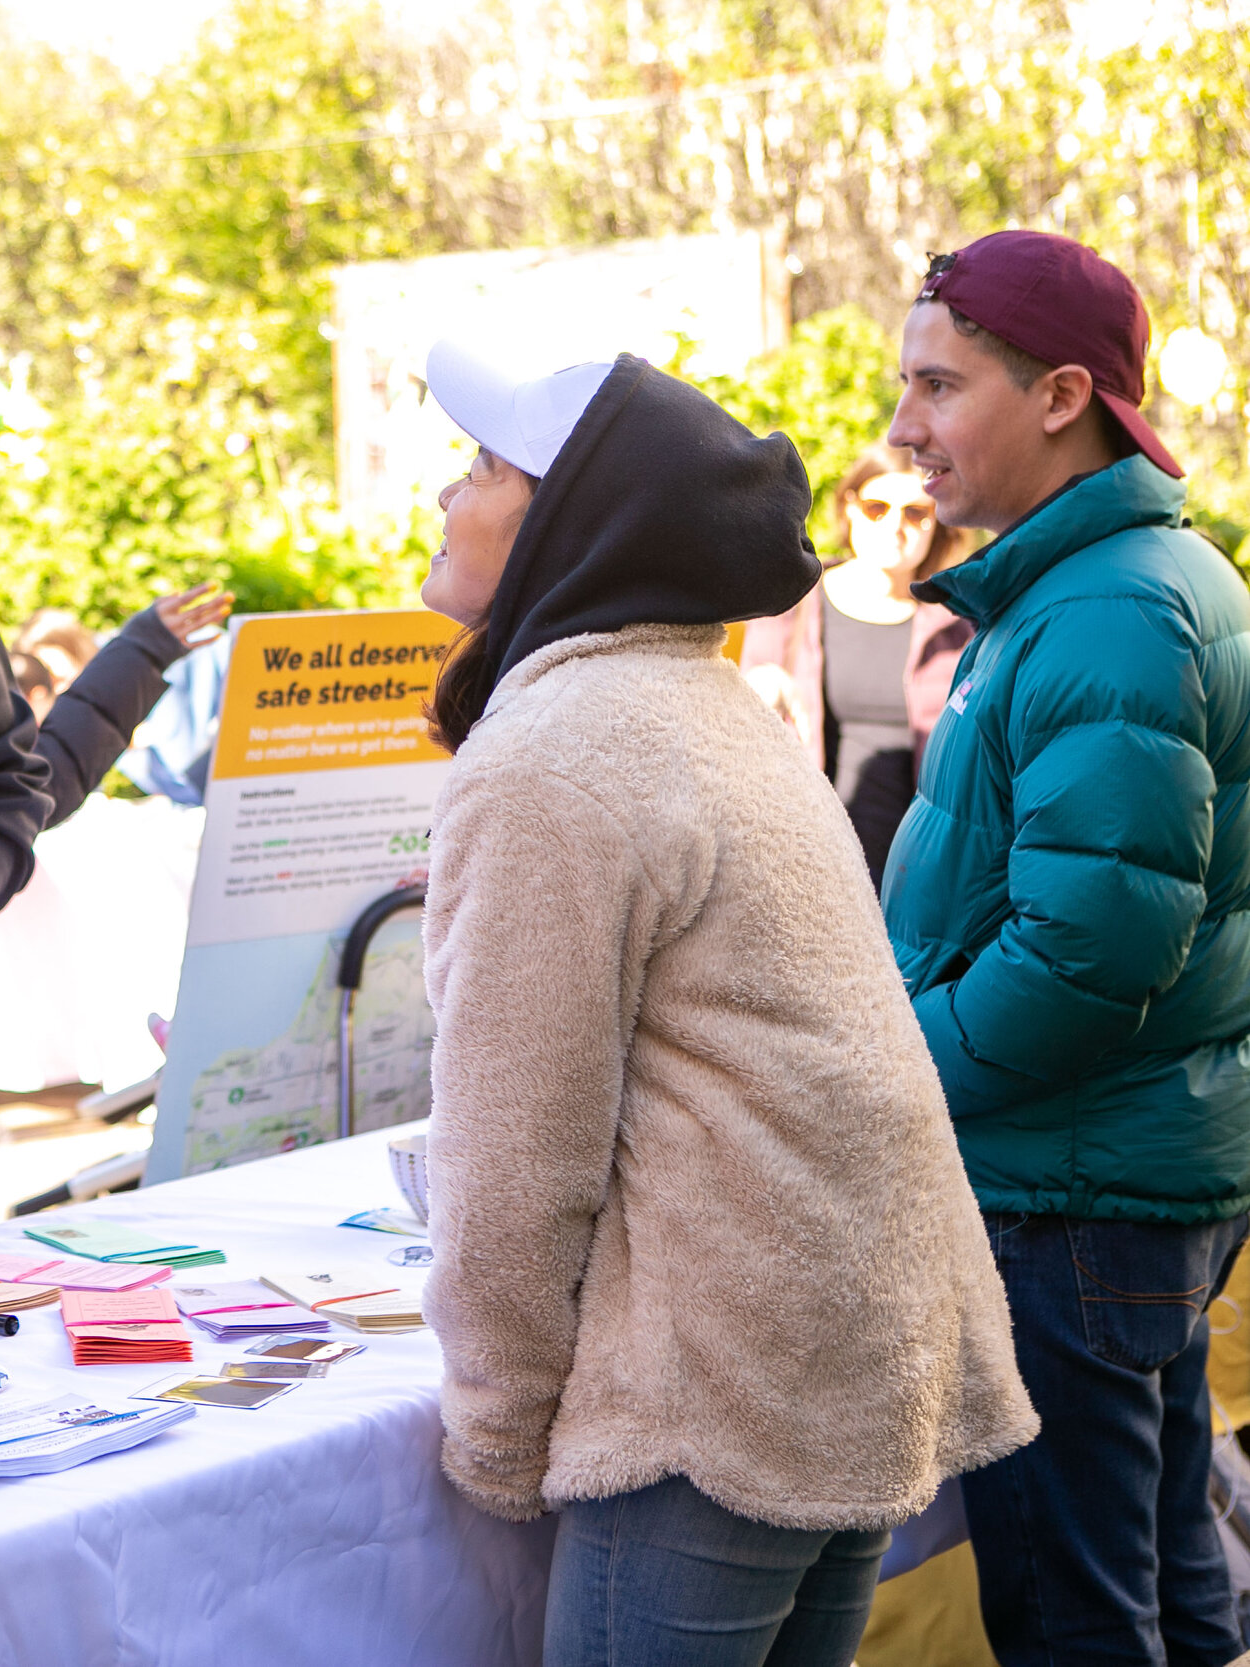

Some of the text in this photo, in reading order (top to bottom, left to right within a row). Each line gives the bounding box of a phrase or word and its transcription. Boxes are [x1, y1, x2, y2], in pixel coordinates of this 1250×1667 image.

[263, 646, 303, 672] We
[309, 643, 343, 670] all
[256, 678, 429, 709] safe streets—
[270, 723, 314, 740] matter
[315, 721, 355, 737] where
[245, 748, 263, 762] no
[265, 744, 307, 760] matter
[309, 742, 336, 757] how
[338, 741, 358, 754] we
[359, 738, 382, 757] get
[239, 788, 296, 800] Instructions
